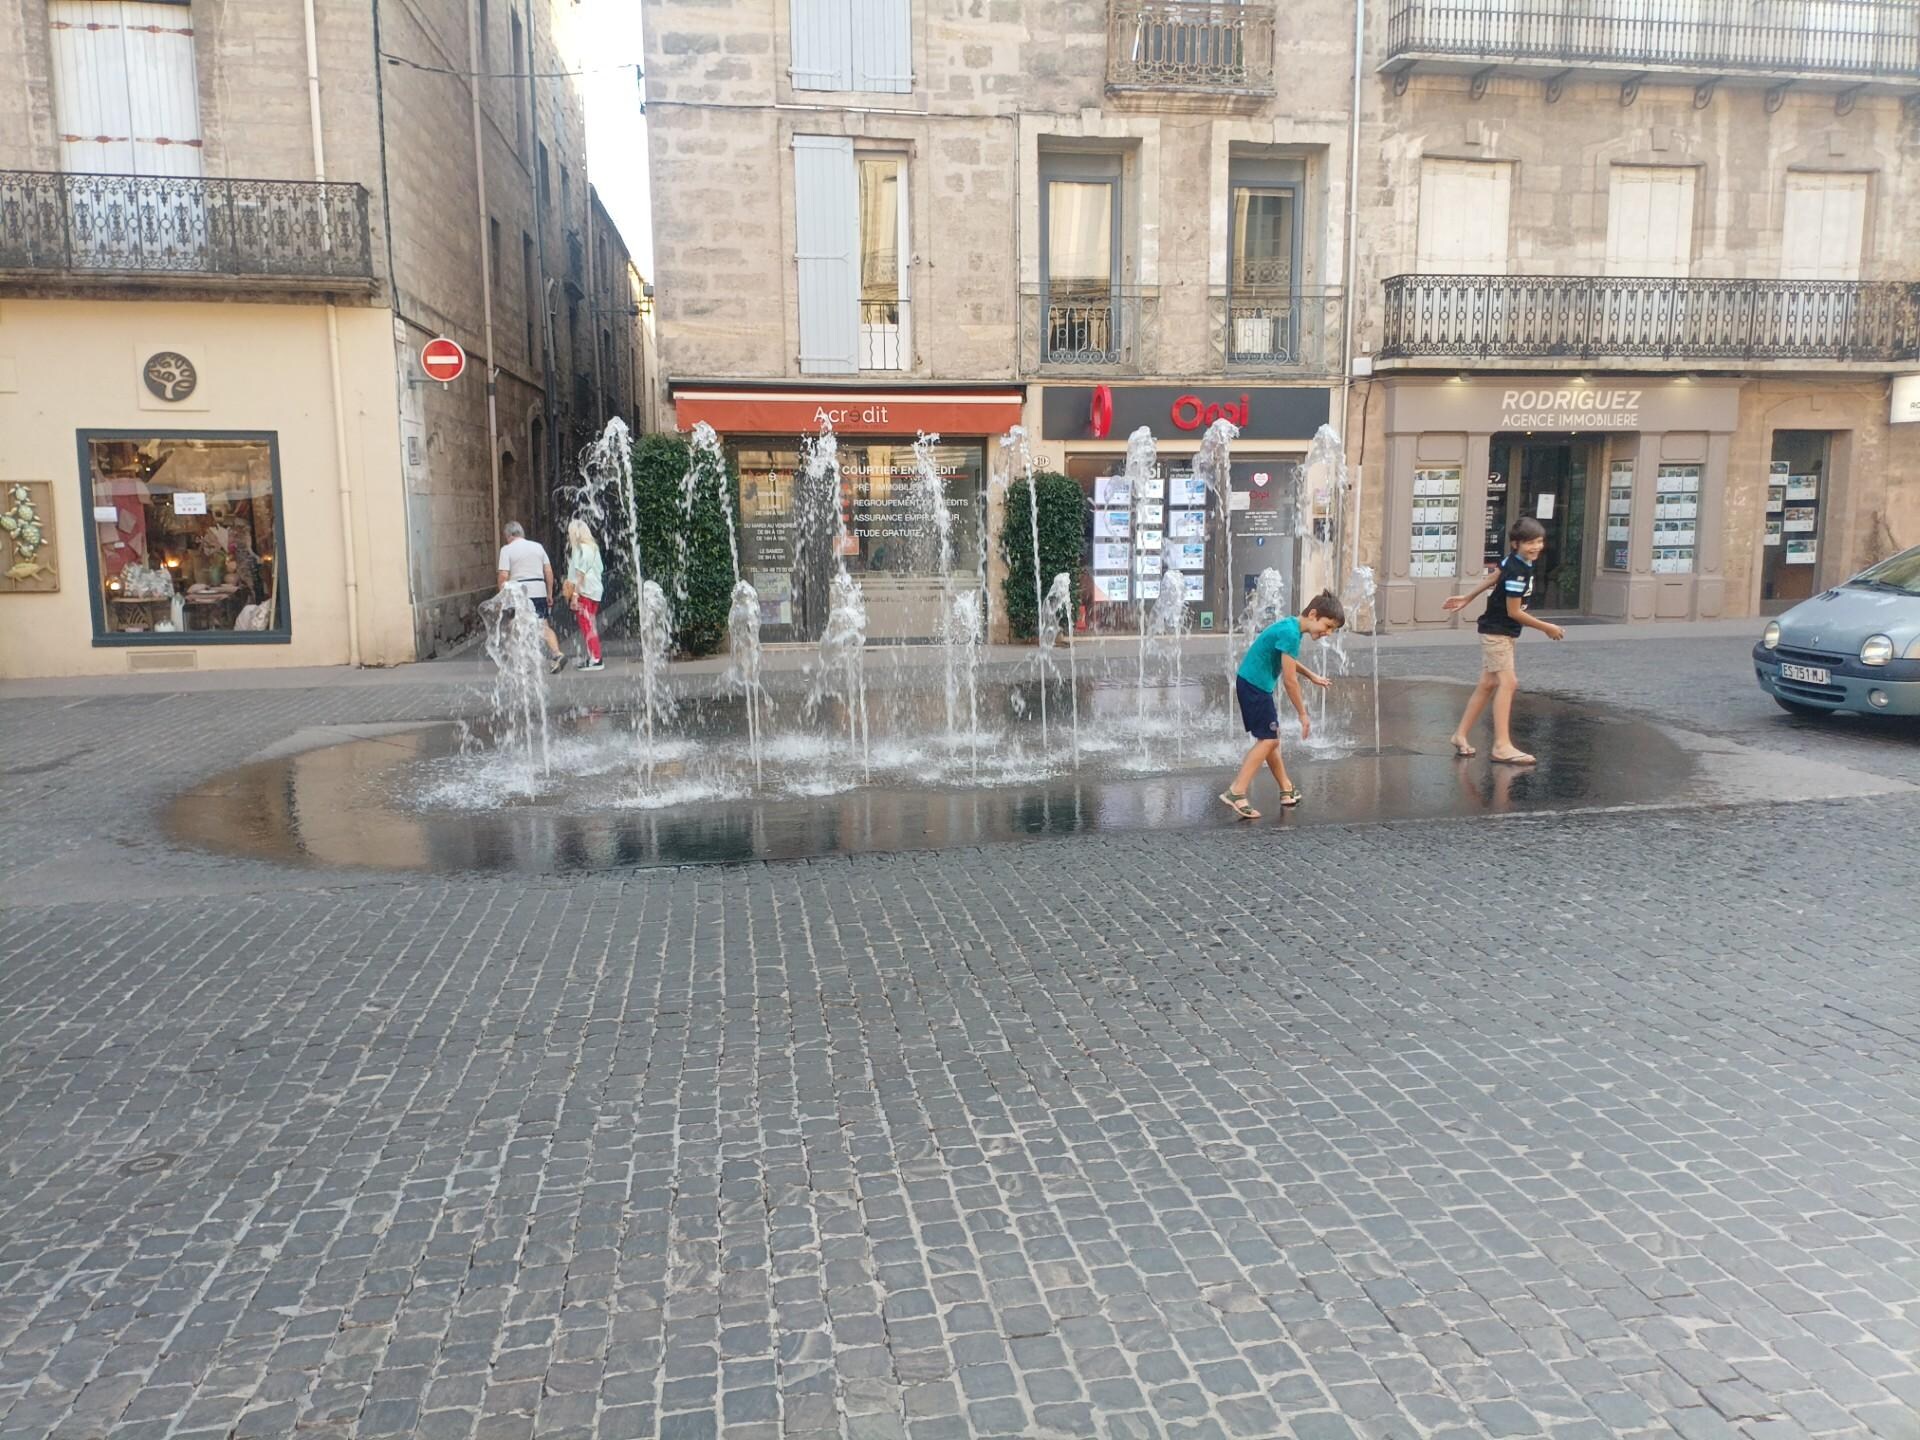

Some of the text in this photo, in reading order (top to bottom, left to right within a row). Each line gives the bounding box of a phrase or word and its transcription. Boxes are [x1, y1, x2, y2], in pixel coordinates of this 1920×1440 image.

[1501, 390, 1643, 410] RODRIGUEZ
[1501, 413, 1638, 427] AGENCE IMMOBILIERE
[842, 465, 898, 475] COURTIER
[900, 465, 915, 475] EN
[853, 499, 919, 507] REGROUPEMENT
[853, 513, 903, 522] ASSURANCE
